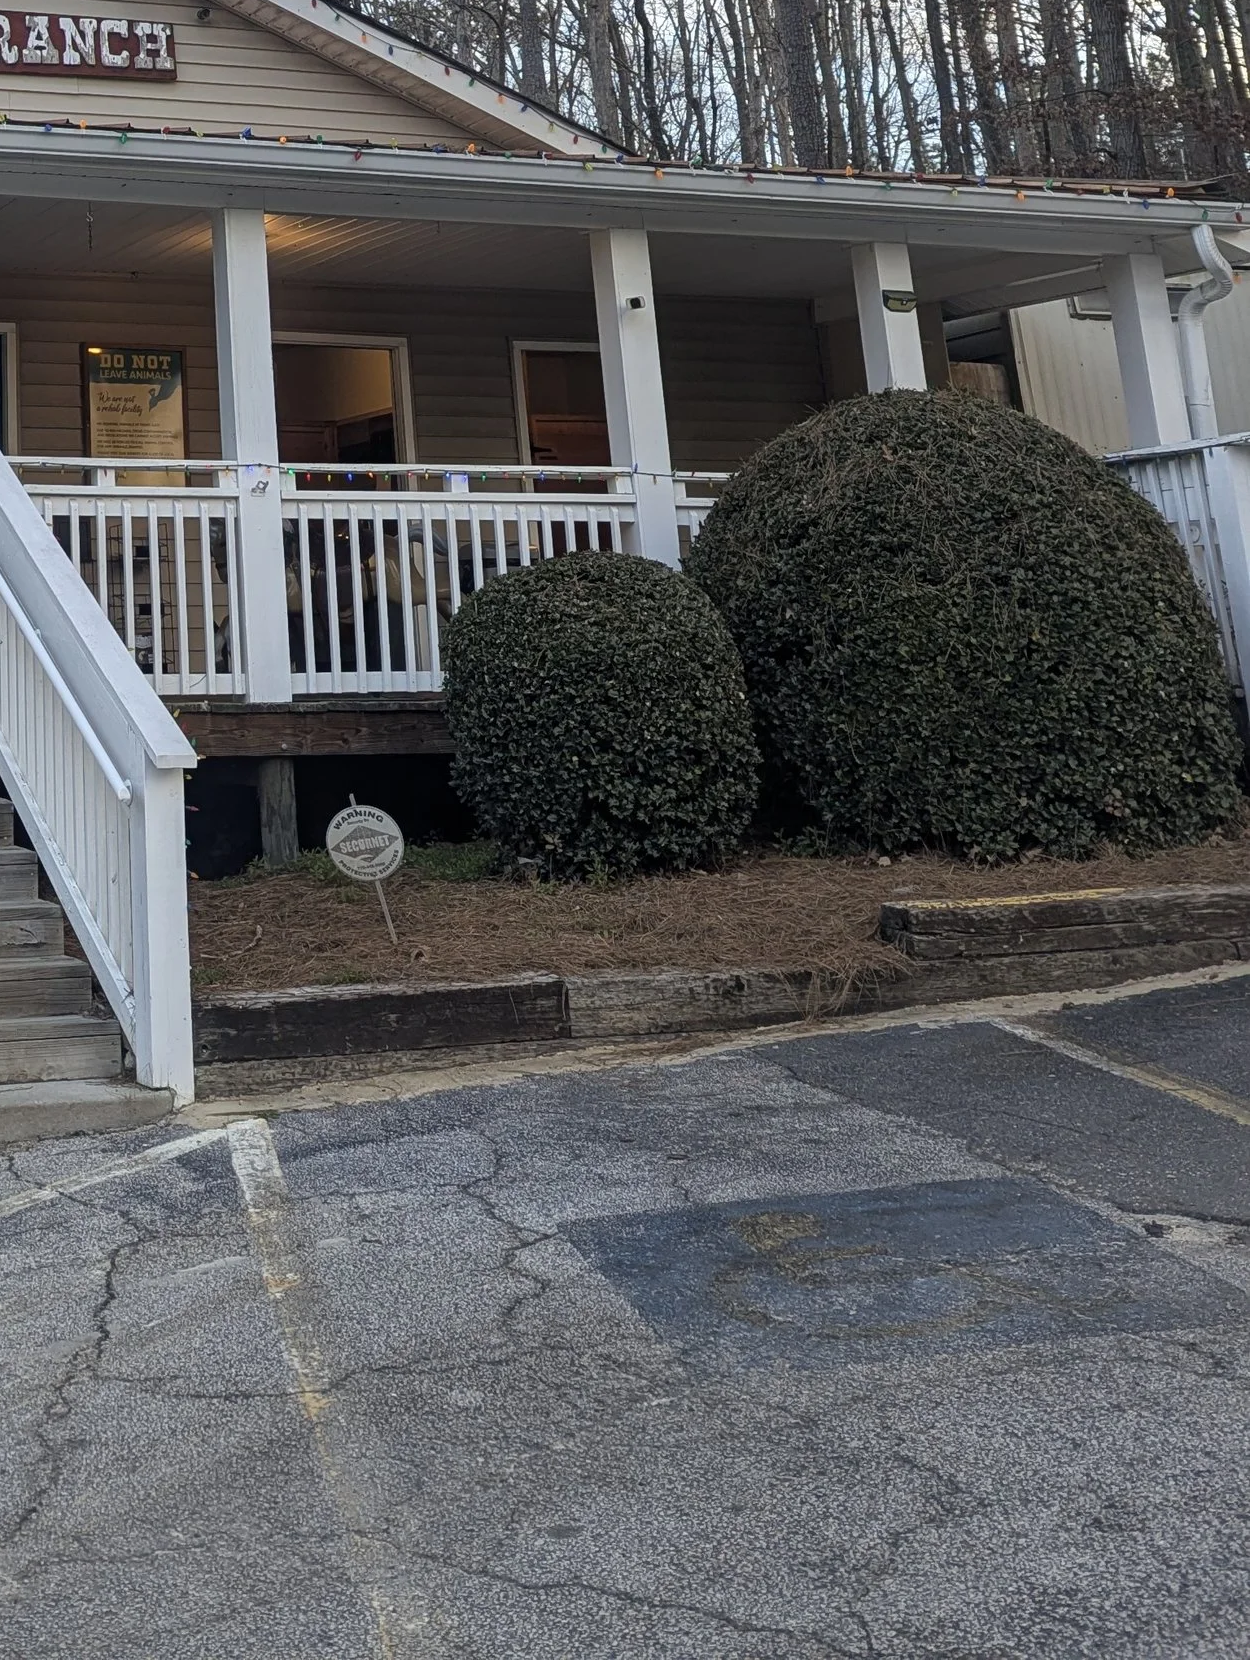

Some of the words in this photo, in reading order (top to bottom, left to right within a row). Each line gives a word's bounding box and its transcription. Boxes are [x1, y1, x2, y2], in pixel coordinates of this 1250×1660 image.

[99, 353, 125, 368] DO
[132, 355, 171, 370] NOT
[99, 369, 128, 379] LEAVE
[130, 370, 171, 380] ANIMALS
[124, 395, 136, 403] not
[333, 809, 384, 830] WARNING
